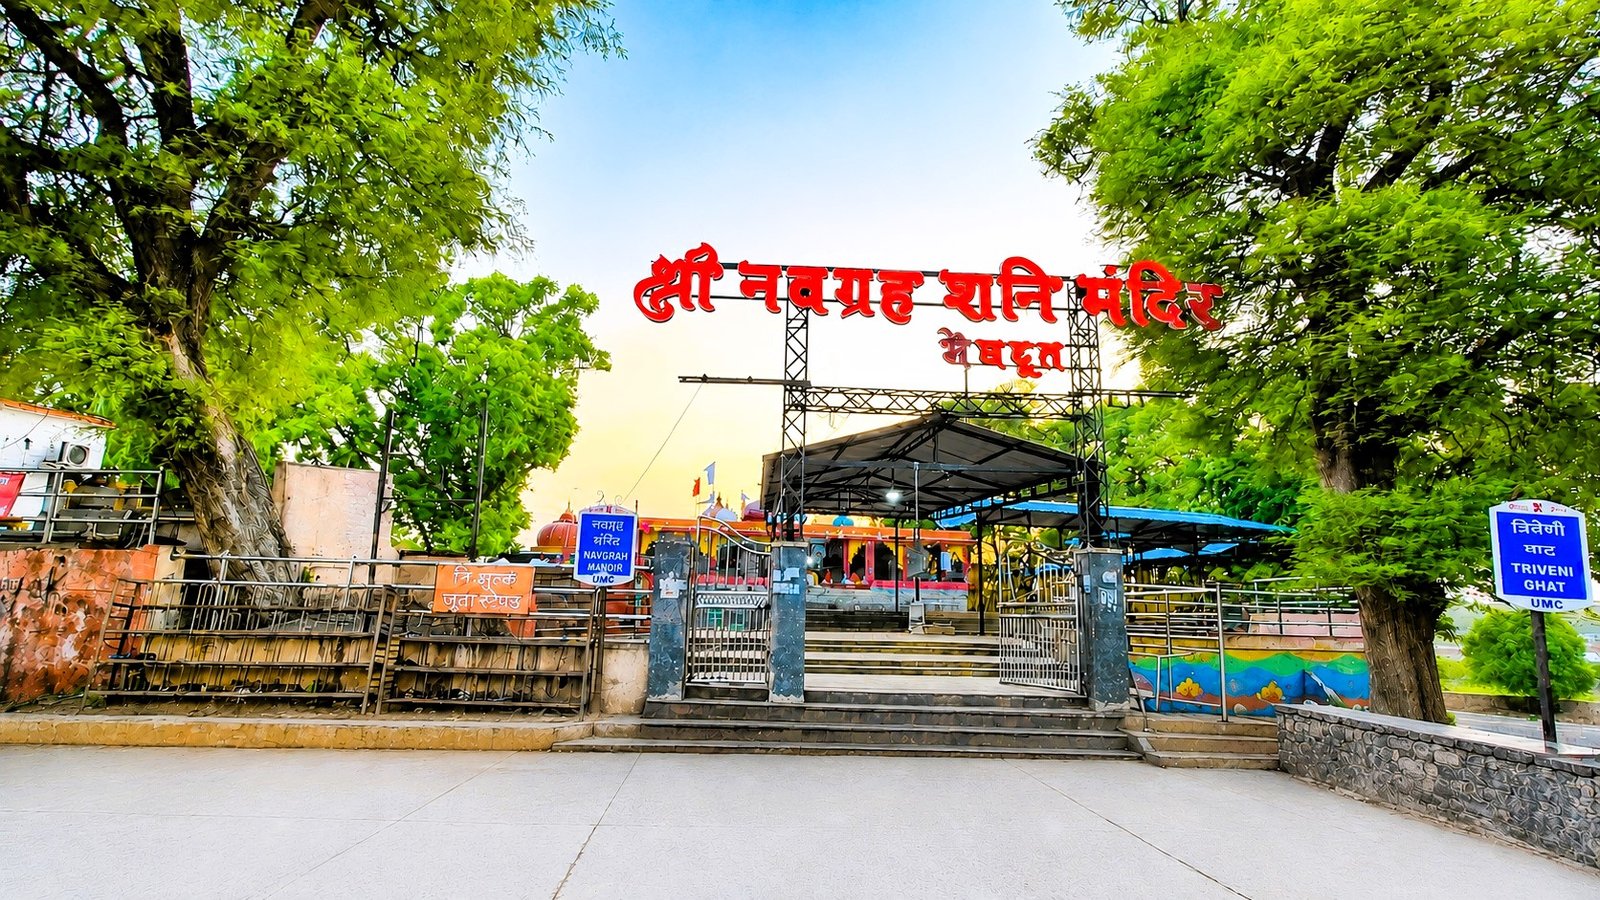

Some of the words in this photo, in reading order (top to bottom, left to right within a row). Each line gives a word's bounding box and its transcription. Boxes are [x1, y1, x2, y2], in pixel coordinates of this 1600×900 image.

[633, 242, 724, 323] श्री
[737, 260, 925, 324] नवग्रह
[938, 256, 1064, 324] शनि
[1075, 259, 1227, 331] मंदिर
[1510, 518, 1566, 537] त्रिवेणी
[583, 551, 628, 561] NAVGRAH
[1522, 544, 1556, 557] घाट
[1510, 562, 1574, 577] TRIVENI
[592, 575, 615, 584] UMC
[1523, 579, 1566, 593] GHAT
[1530, 598, 1564, 609] UMC
